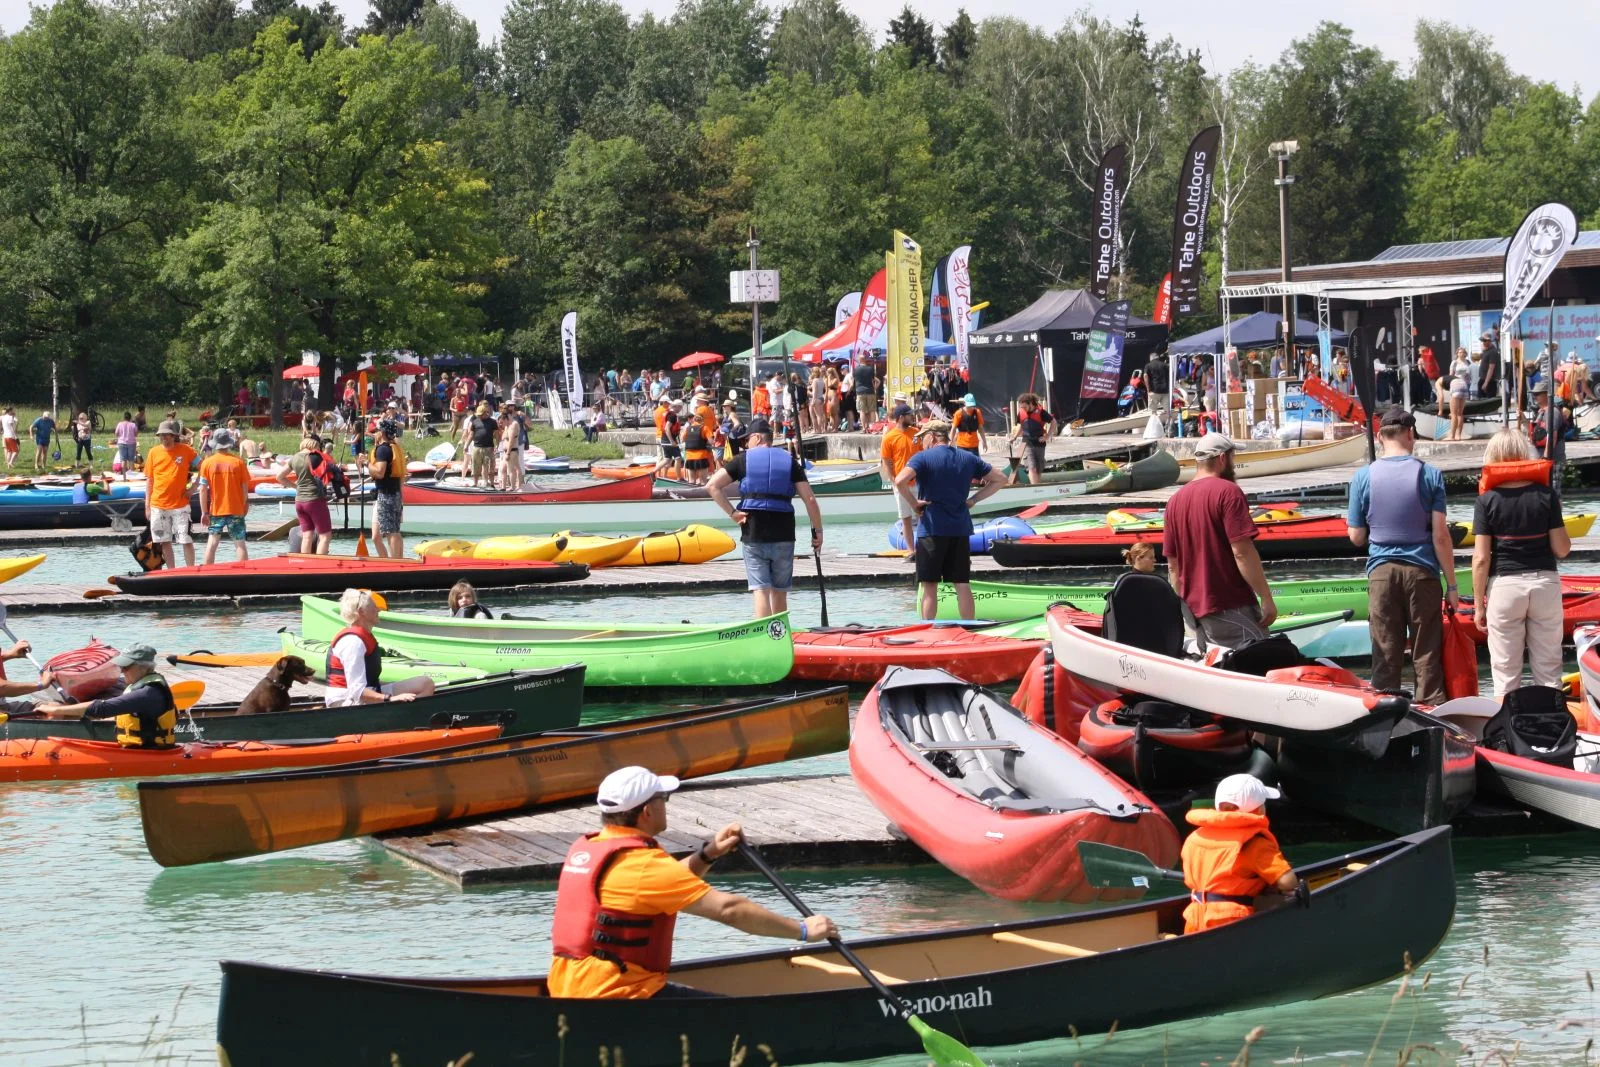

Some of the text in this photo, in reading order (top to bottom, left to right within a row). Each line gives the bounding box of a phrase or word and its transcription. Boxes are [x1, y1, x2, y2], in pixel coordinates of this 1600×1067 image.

[1097, 168, 1114, 282] Tahe Outdoors
[1179, 151, 1207, 272] Tahe Outdoors
[565, 339, 574, 392] INDIANA
[496, 646, 532, 654] Lettmann
[514, 679, 552, 692] PENOBSCOT
